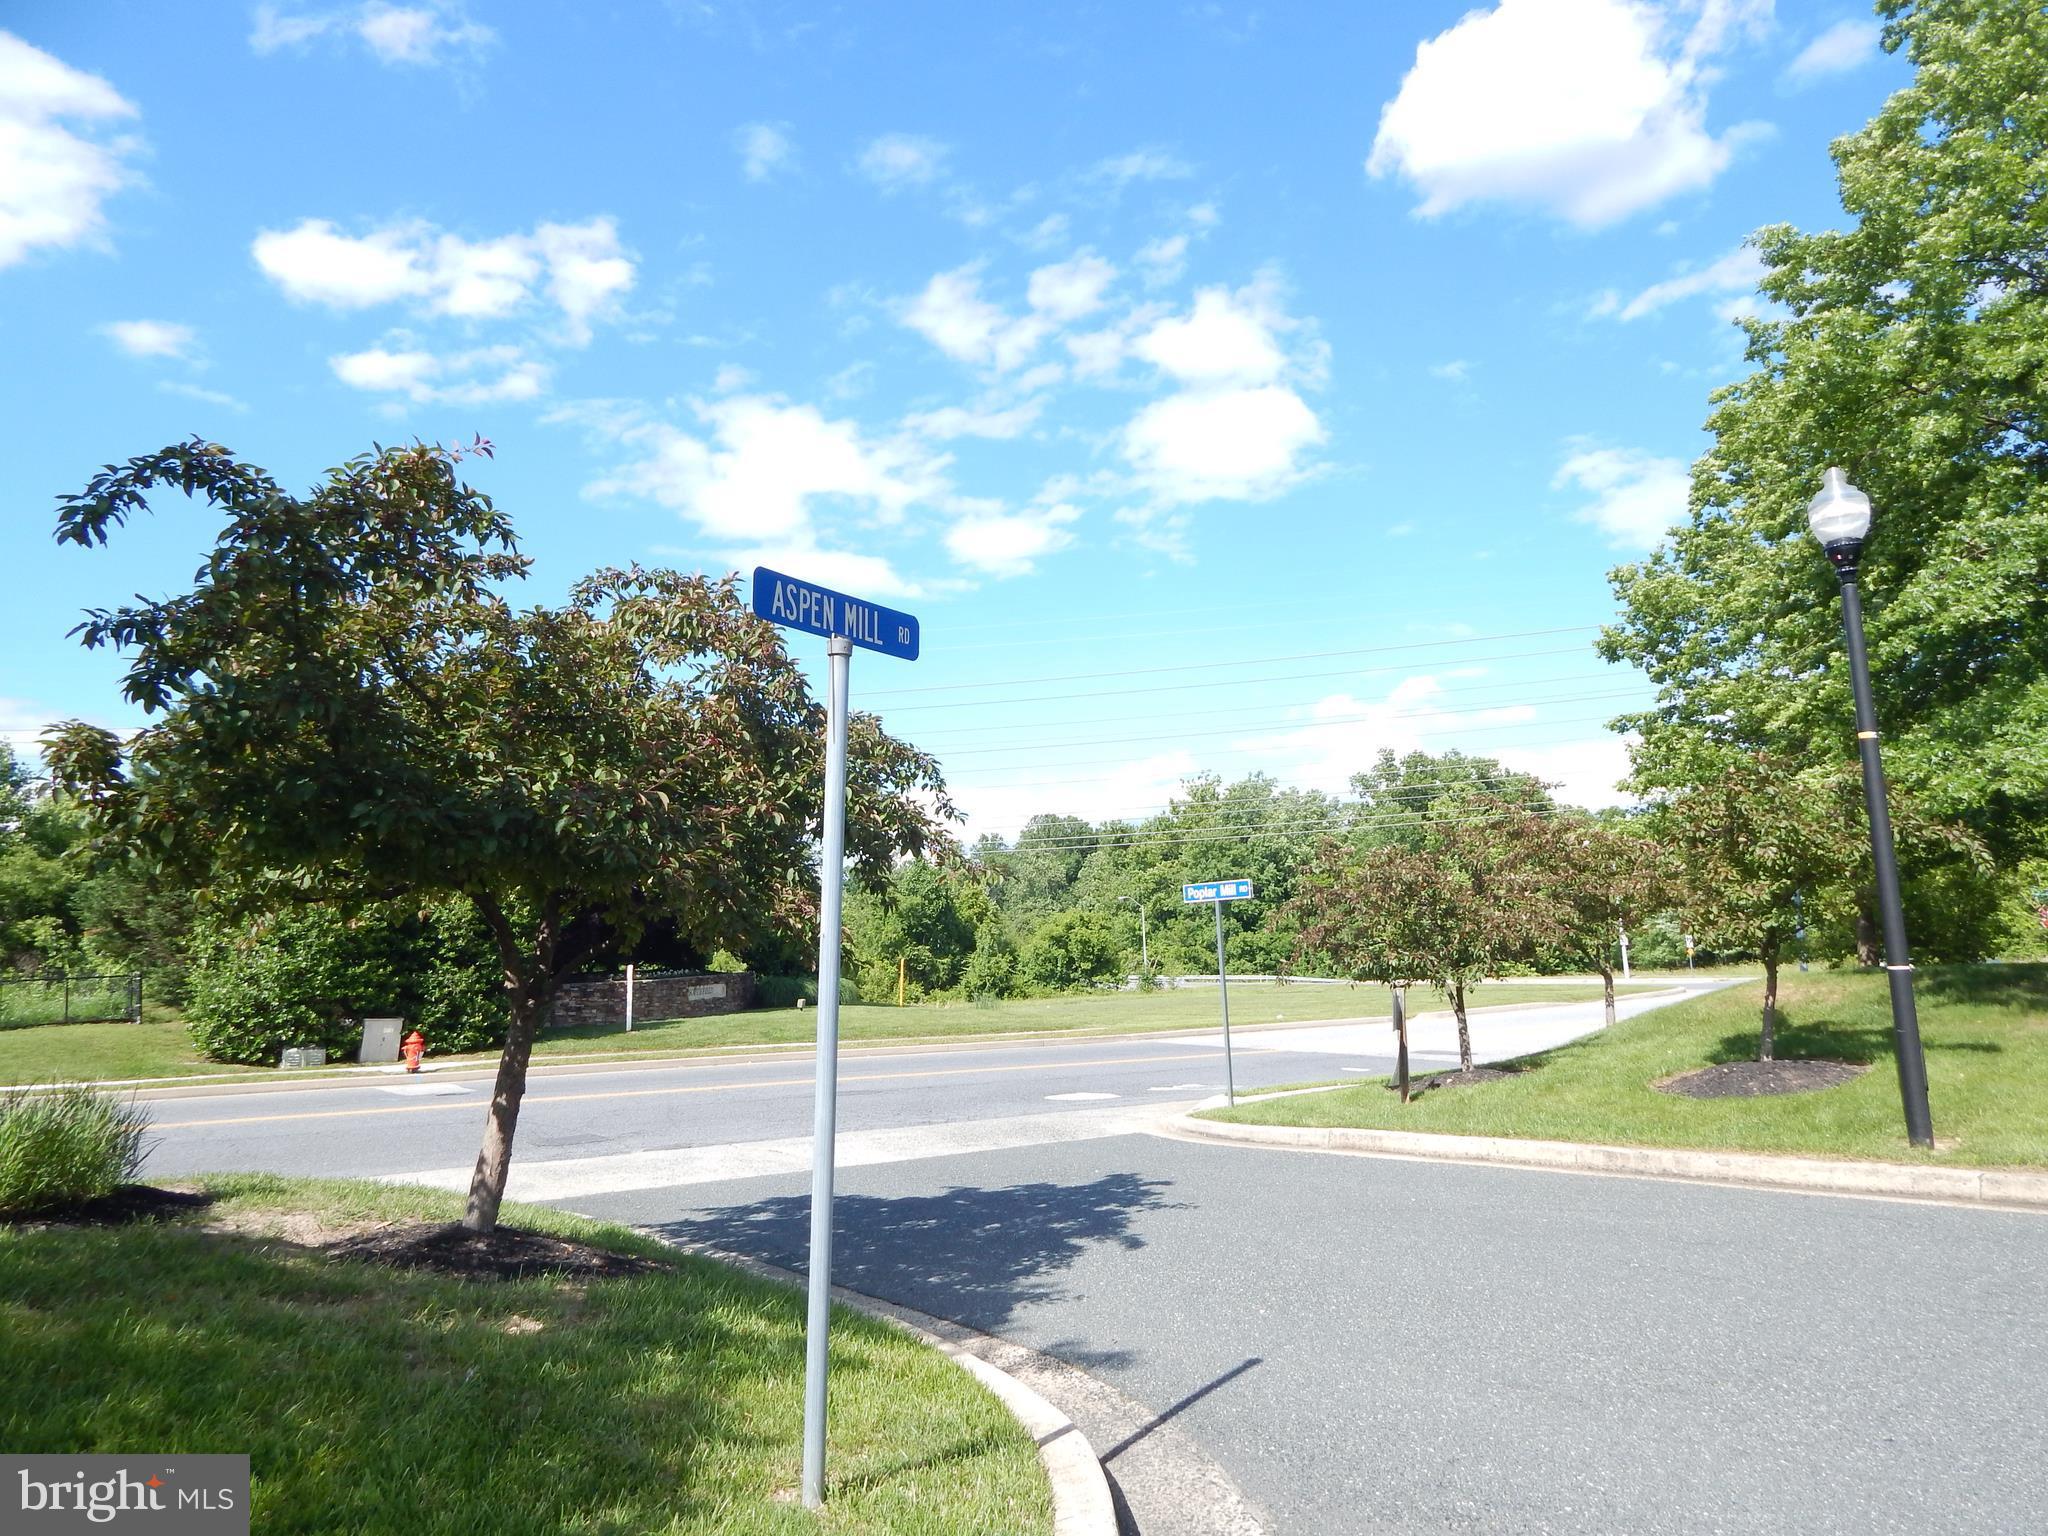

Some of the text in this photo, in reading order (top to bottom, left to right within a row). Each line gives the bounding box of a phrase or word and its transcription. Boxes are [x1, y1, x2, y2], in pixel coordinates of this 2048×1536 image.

[772, 580, 910, 646] ASPEN MILL RD
[1187, 885, 1217, 900] Poplar
[1220, 883, 1237, 897] Mill
